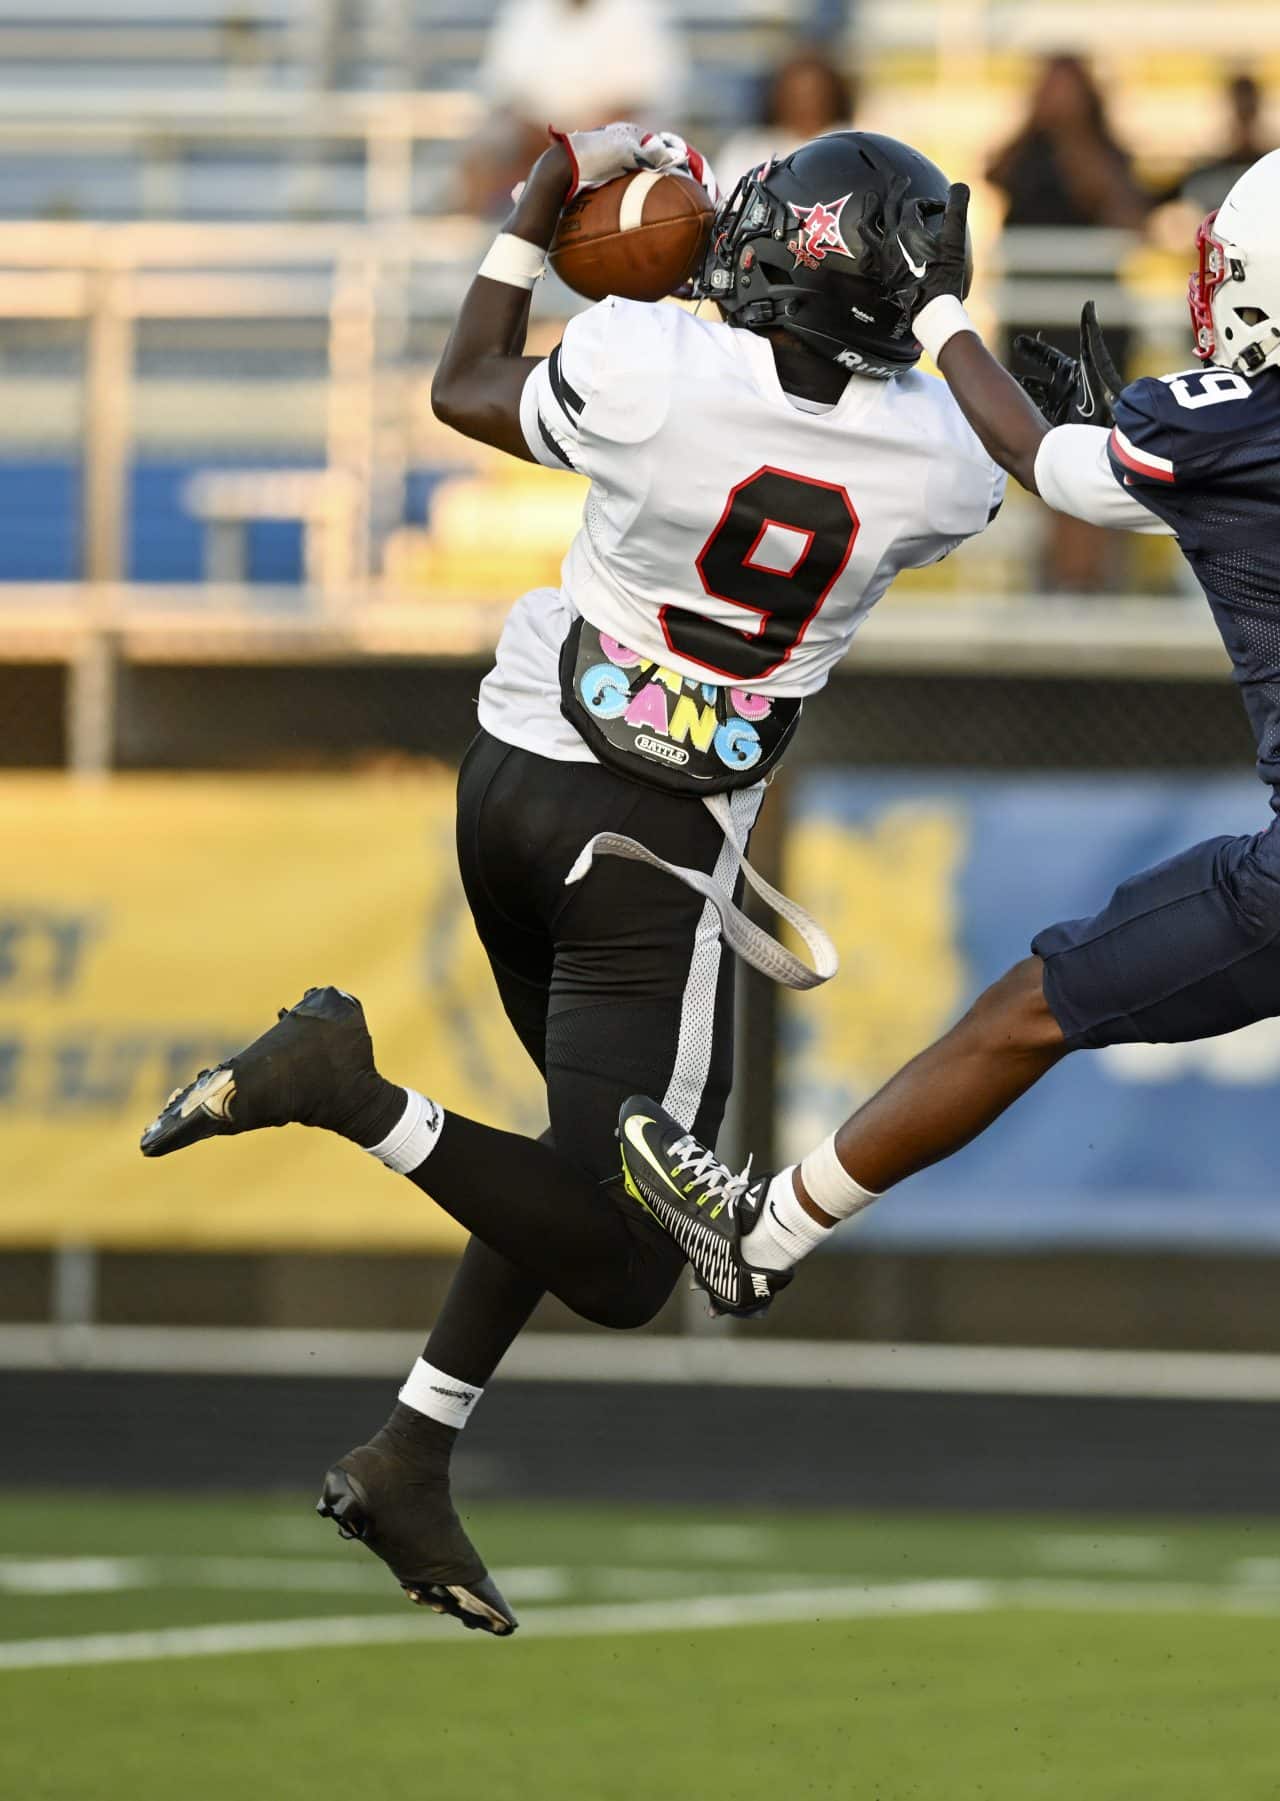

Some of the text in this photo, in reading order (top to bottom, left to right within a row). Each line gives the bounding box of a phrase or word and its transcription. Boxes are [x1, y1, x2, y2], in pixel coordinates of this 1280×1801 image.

[656, 464, 861, 681] 9
[580, 663, 763, 771] GANG
[639, 736, 686, 762] BATTLE
[751, 1272, 770, 1298] NIKE
